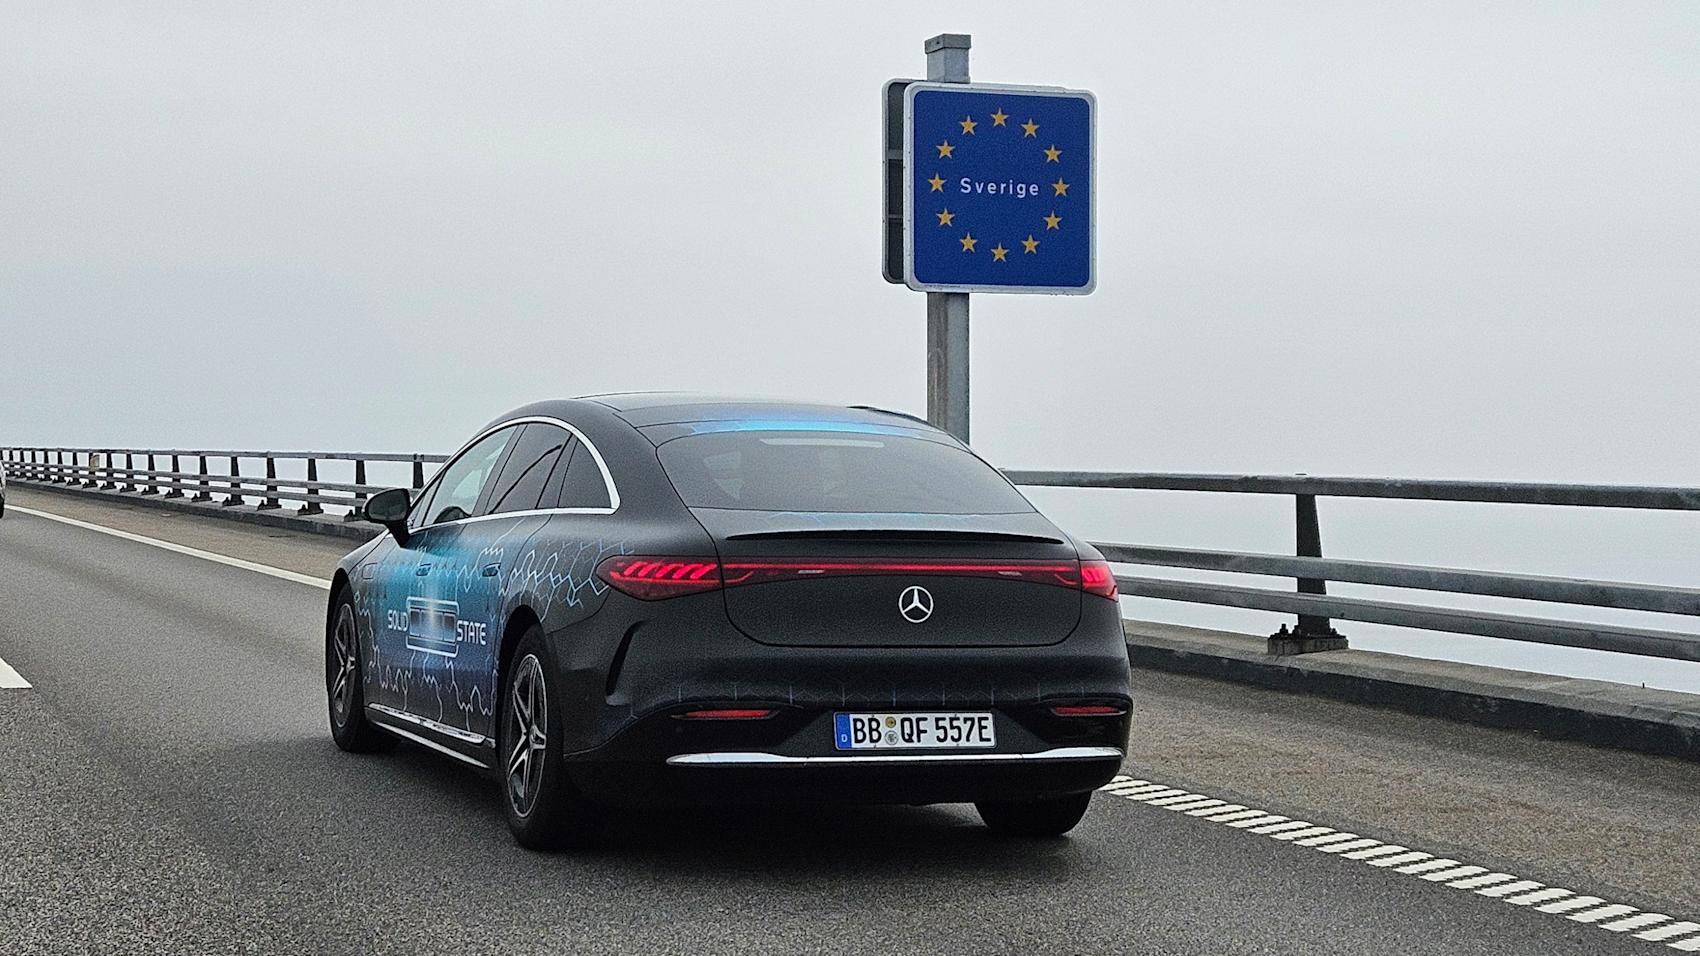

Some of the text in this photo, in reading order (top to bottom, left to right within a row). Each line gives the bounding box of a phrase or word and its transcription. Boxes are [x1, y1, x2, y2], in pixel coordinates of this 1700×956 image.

[960, 177, 1039, 198] Sverige
[387, 609, 487, 645] SOLID STATE
[841, 735, 848, 743] D
[852, 716, 992, 744] BB QF 557E
